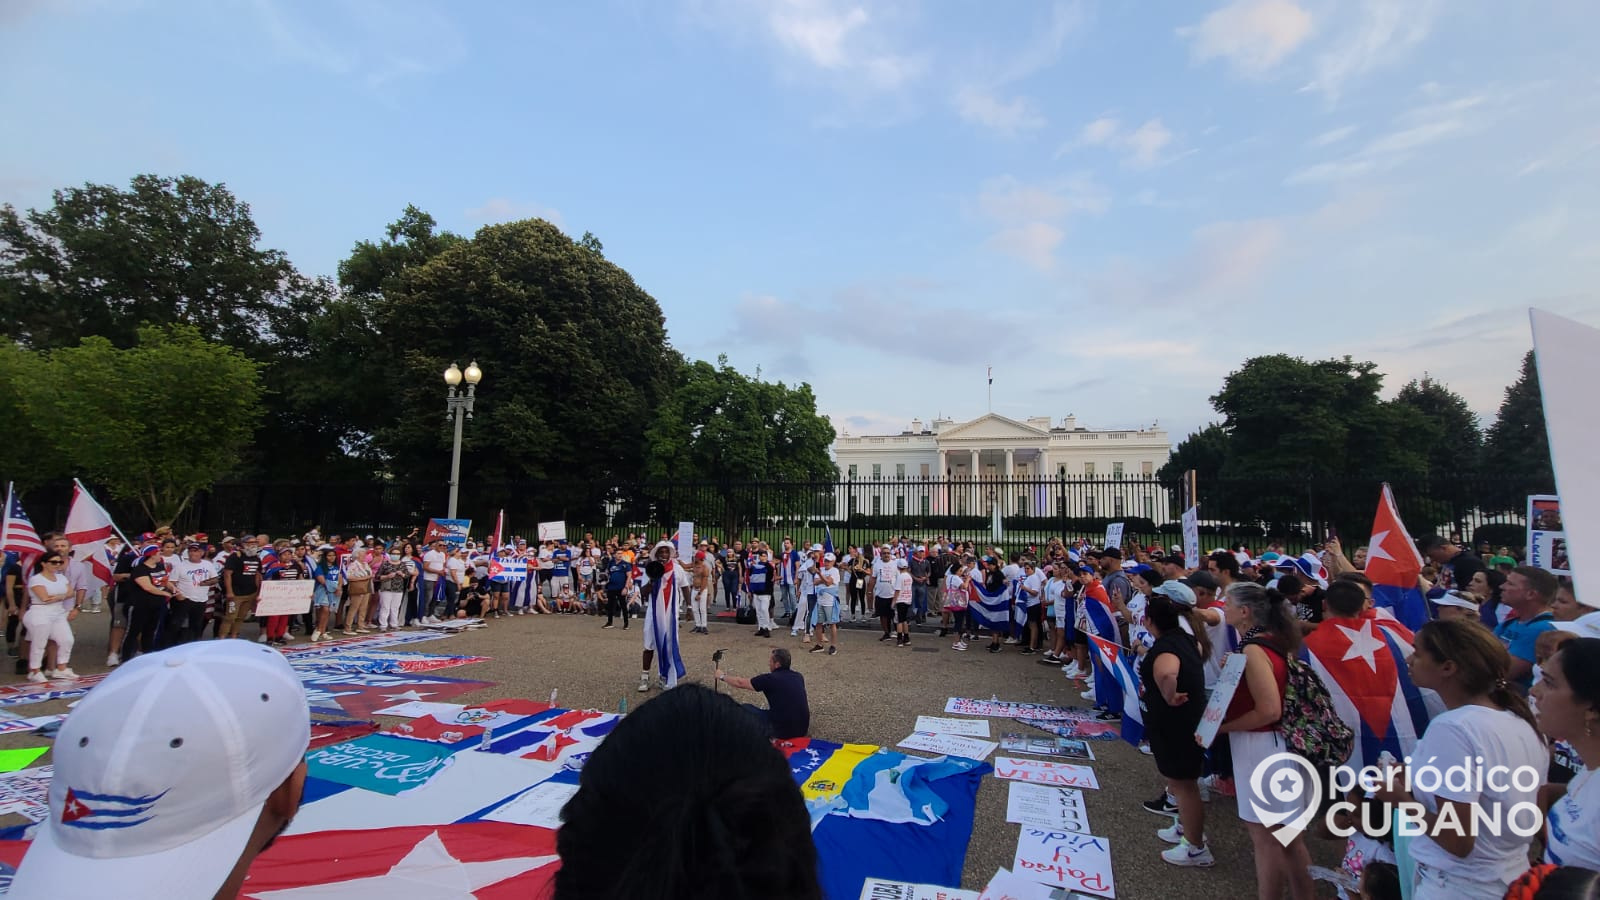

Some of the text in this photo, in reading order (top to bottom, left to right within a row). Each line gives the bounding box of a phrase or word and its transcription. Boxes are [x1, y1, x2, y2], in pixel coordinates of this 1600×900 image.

[1532, 532, 1543, 568] FRE
[330, 743, 411, 762] DECIDE
[1009, 759, 1077, 772] VIDA
[996, 767, 1092, 787] PATRIA
[1026, 828, 1105, 852] Vida
[1018, 858, 1110, 892] Patria
